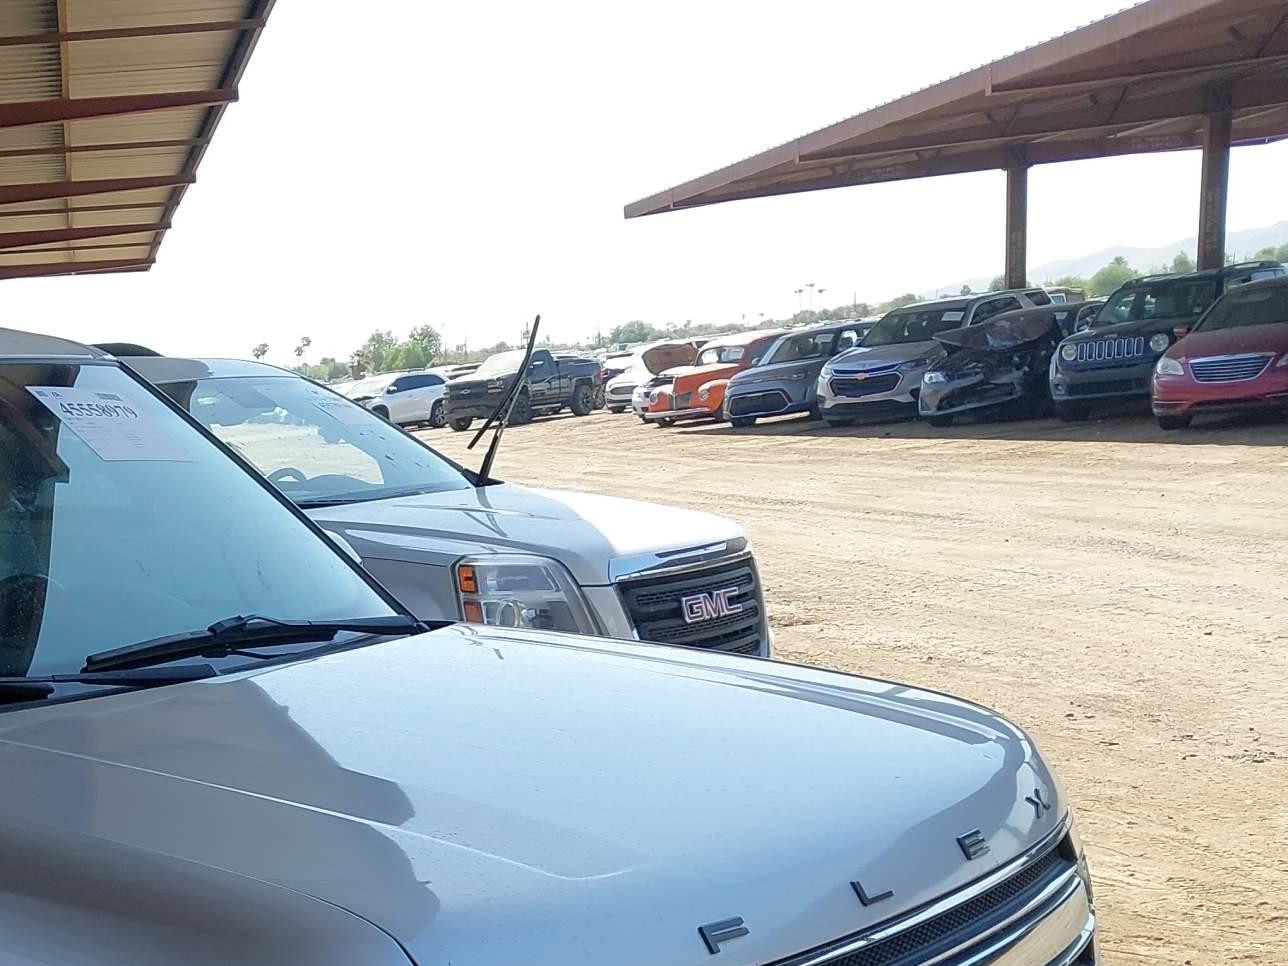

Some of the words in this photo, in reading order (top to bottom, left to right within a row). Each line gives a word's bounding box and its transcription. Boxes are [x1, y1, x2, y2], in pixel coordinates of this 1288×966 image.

[60, 402, 139, 419] 45558979
[681, 586, 743, 624] GMC
[697, 788, 1051, 955] FLEX
